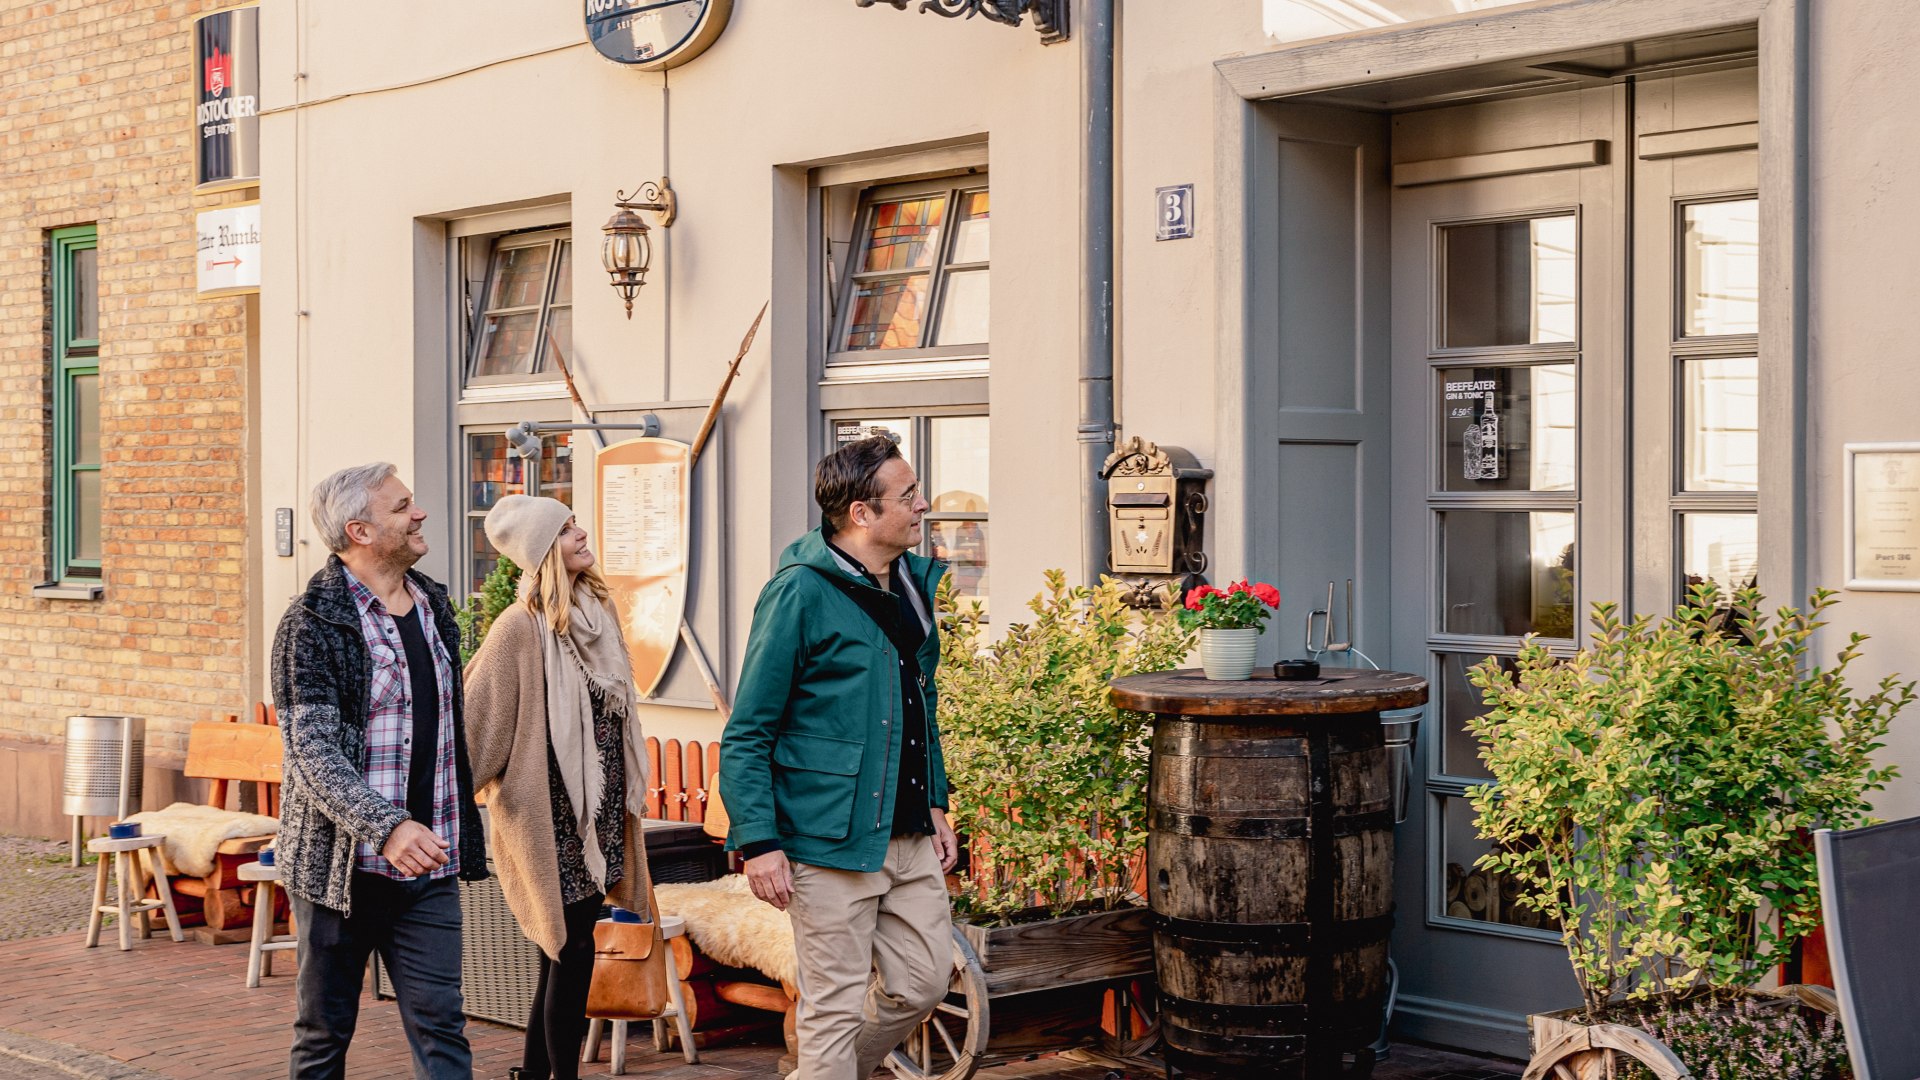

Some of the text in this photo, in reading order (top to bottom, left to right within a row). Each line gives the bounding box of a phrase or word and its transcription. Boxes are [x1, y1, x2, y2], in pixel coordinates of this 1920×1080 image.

[616, 20, 632, 31] SEI
[1165, 193, 1182, 222] 3
[1446, 381, 1495, 391] BEEFEATER
[1445, 391, 1484, 400] GIN & TONIC
